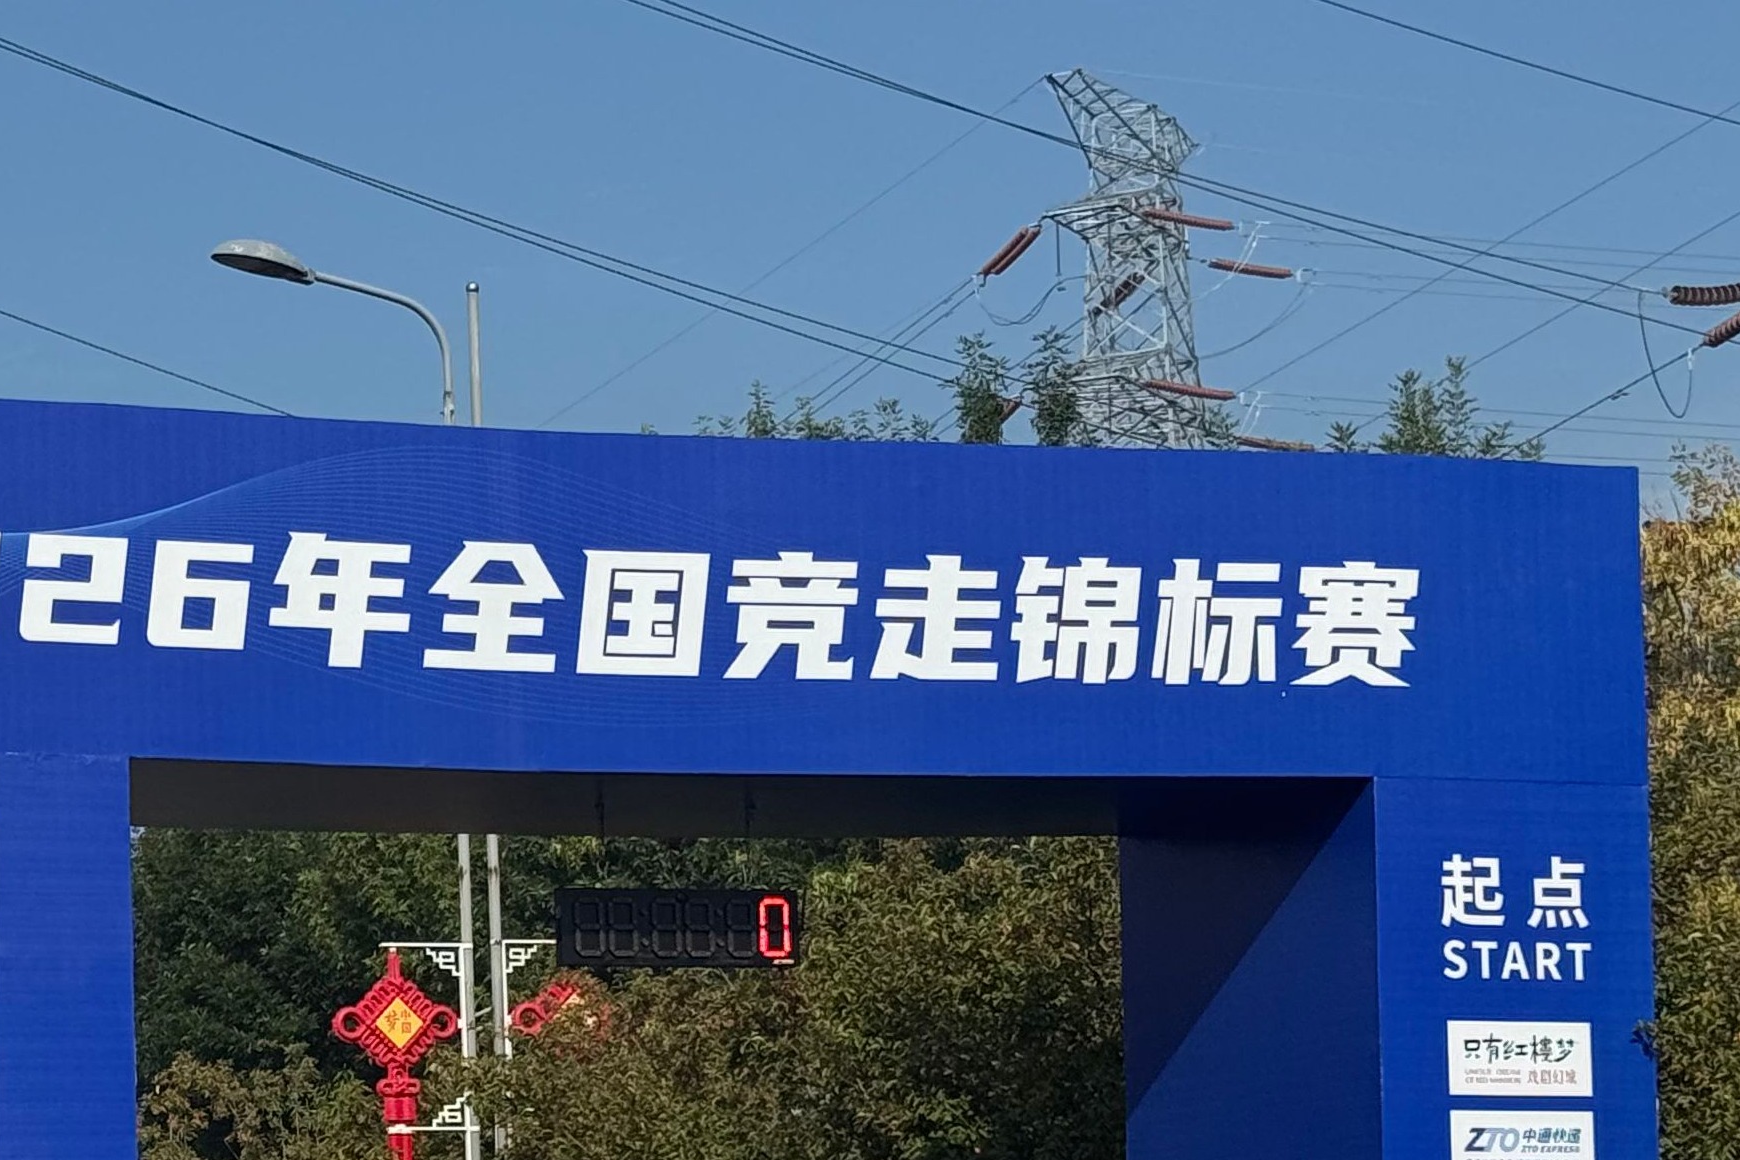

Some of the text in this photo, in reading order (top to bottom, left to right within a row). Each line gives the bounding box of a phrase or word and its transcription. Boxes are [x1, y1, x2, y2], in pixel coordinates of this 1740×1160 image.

[1440, 853, 1592, 929] 起点
[758, 896, 792, 958] 0
[1442, 938, 1592, 982] START
[1464, 1127, 1520, 1153] ZTO
[1522, 1127, 1582, 1144] 中通快递
